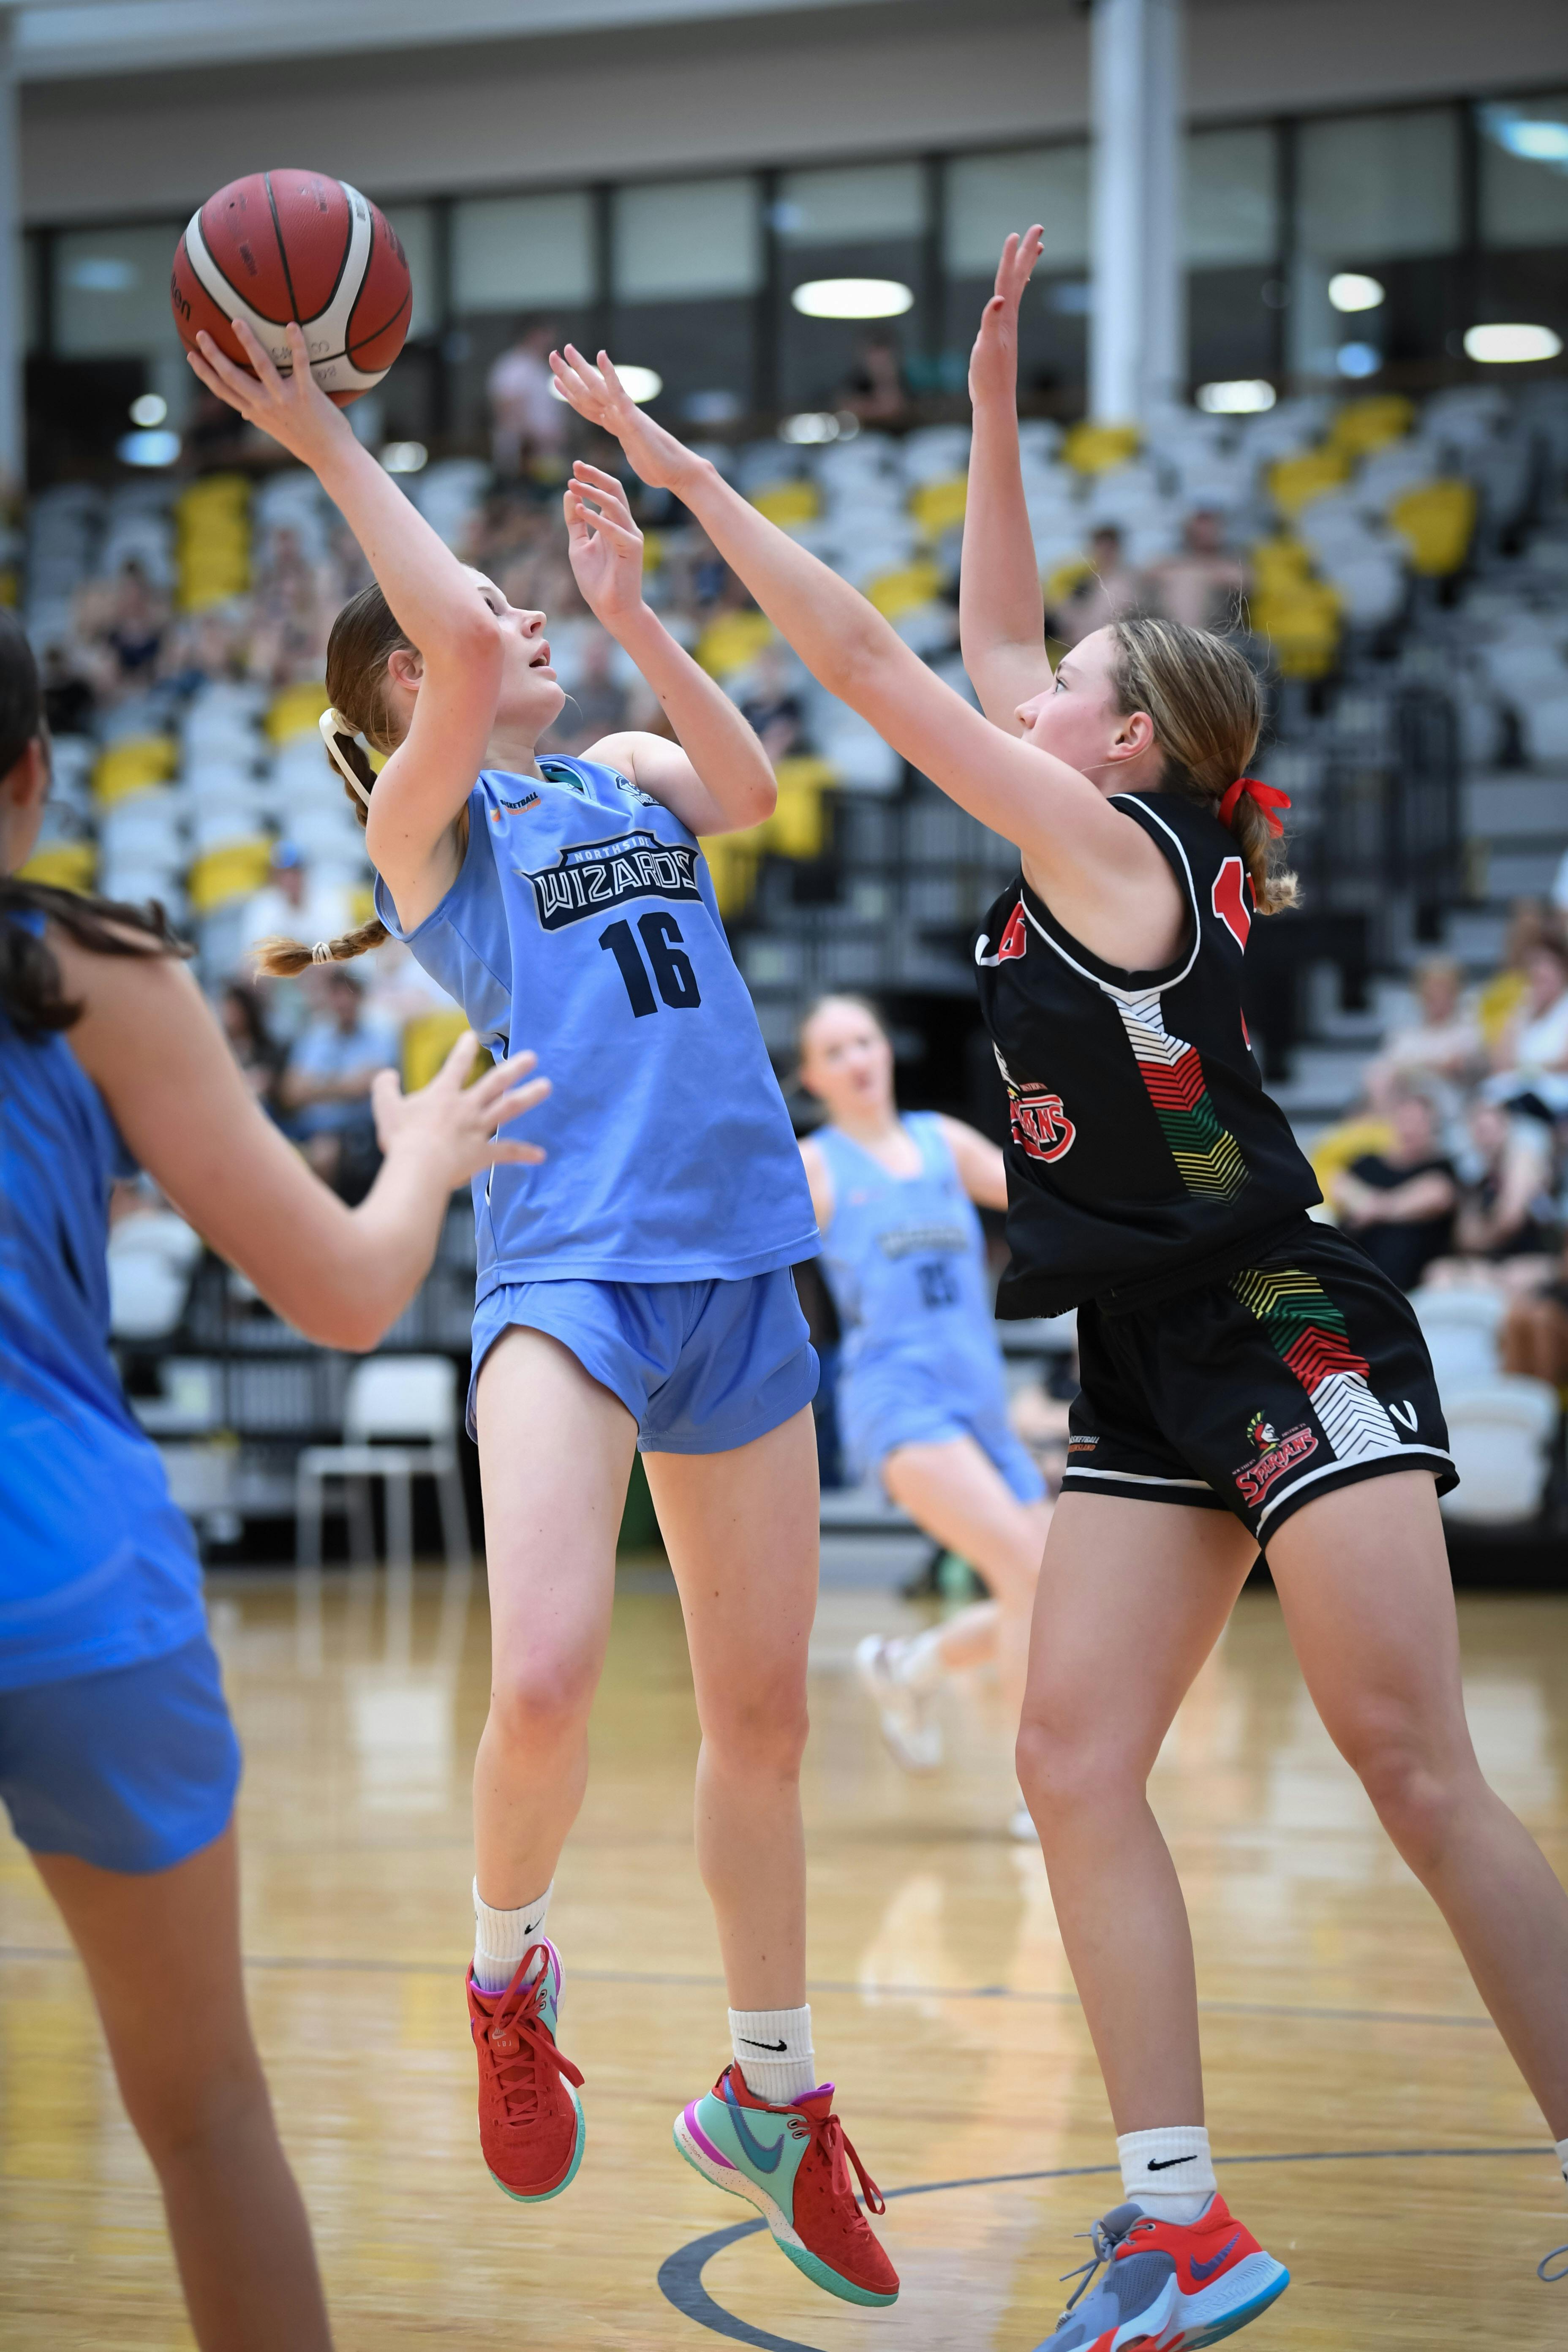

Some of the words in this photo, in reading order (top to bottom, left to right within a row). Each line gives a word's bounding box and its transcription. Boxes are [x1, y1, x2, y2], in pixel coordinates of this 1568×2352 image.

[574, 836, 650, 862] NORTHSIDE
[533, 850, 697, 919] WIZARDS
[598, 912, 702, 1018] 16
[1069, 1435, 1100, 1444] ASKETBALL
